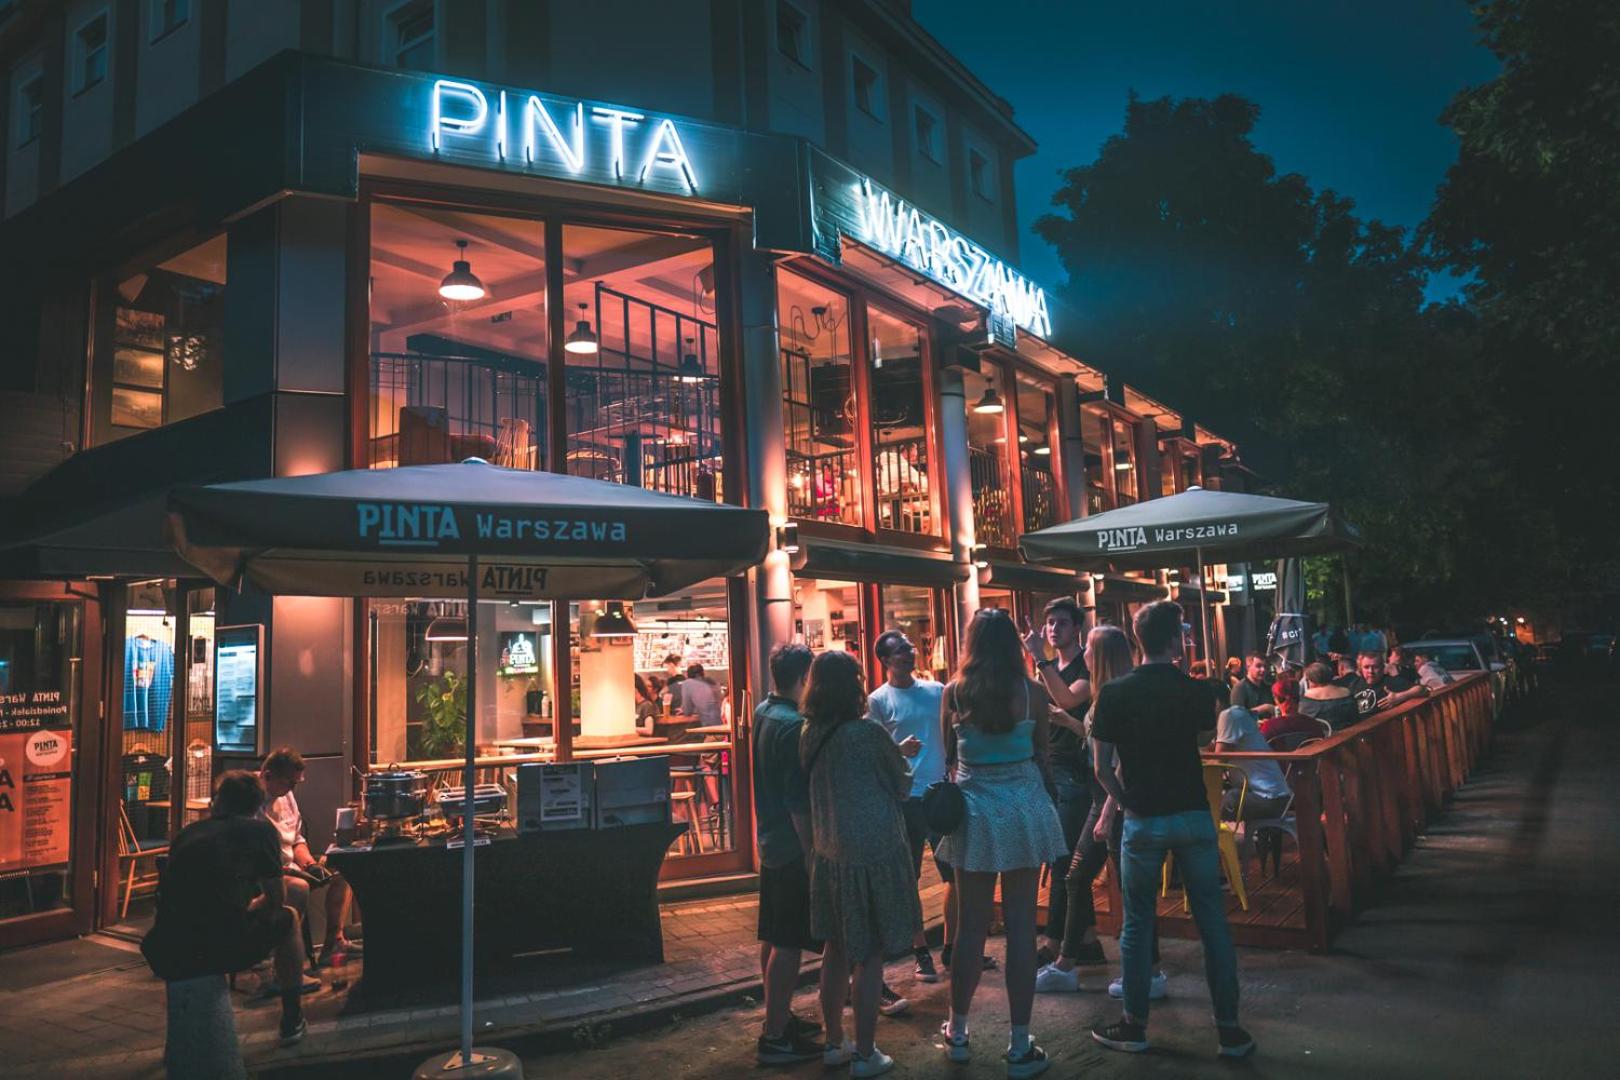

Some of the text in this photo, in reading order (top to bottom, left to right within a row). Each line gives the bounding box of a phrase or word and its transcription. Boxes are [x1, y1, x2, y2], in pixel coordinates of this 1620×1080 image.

[433, 80, 698, 194] PINTA
[855, 178, 1052, 338] WARSZAWA
[356, 503, 626, 542] PINTA Warszawa
[1097, 523, 1238, 548] PINTA Warszawa
[34, 740, 58, 751] PINTA
